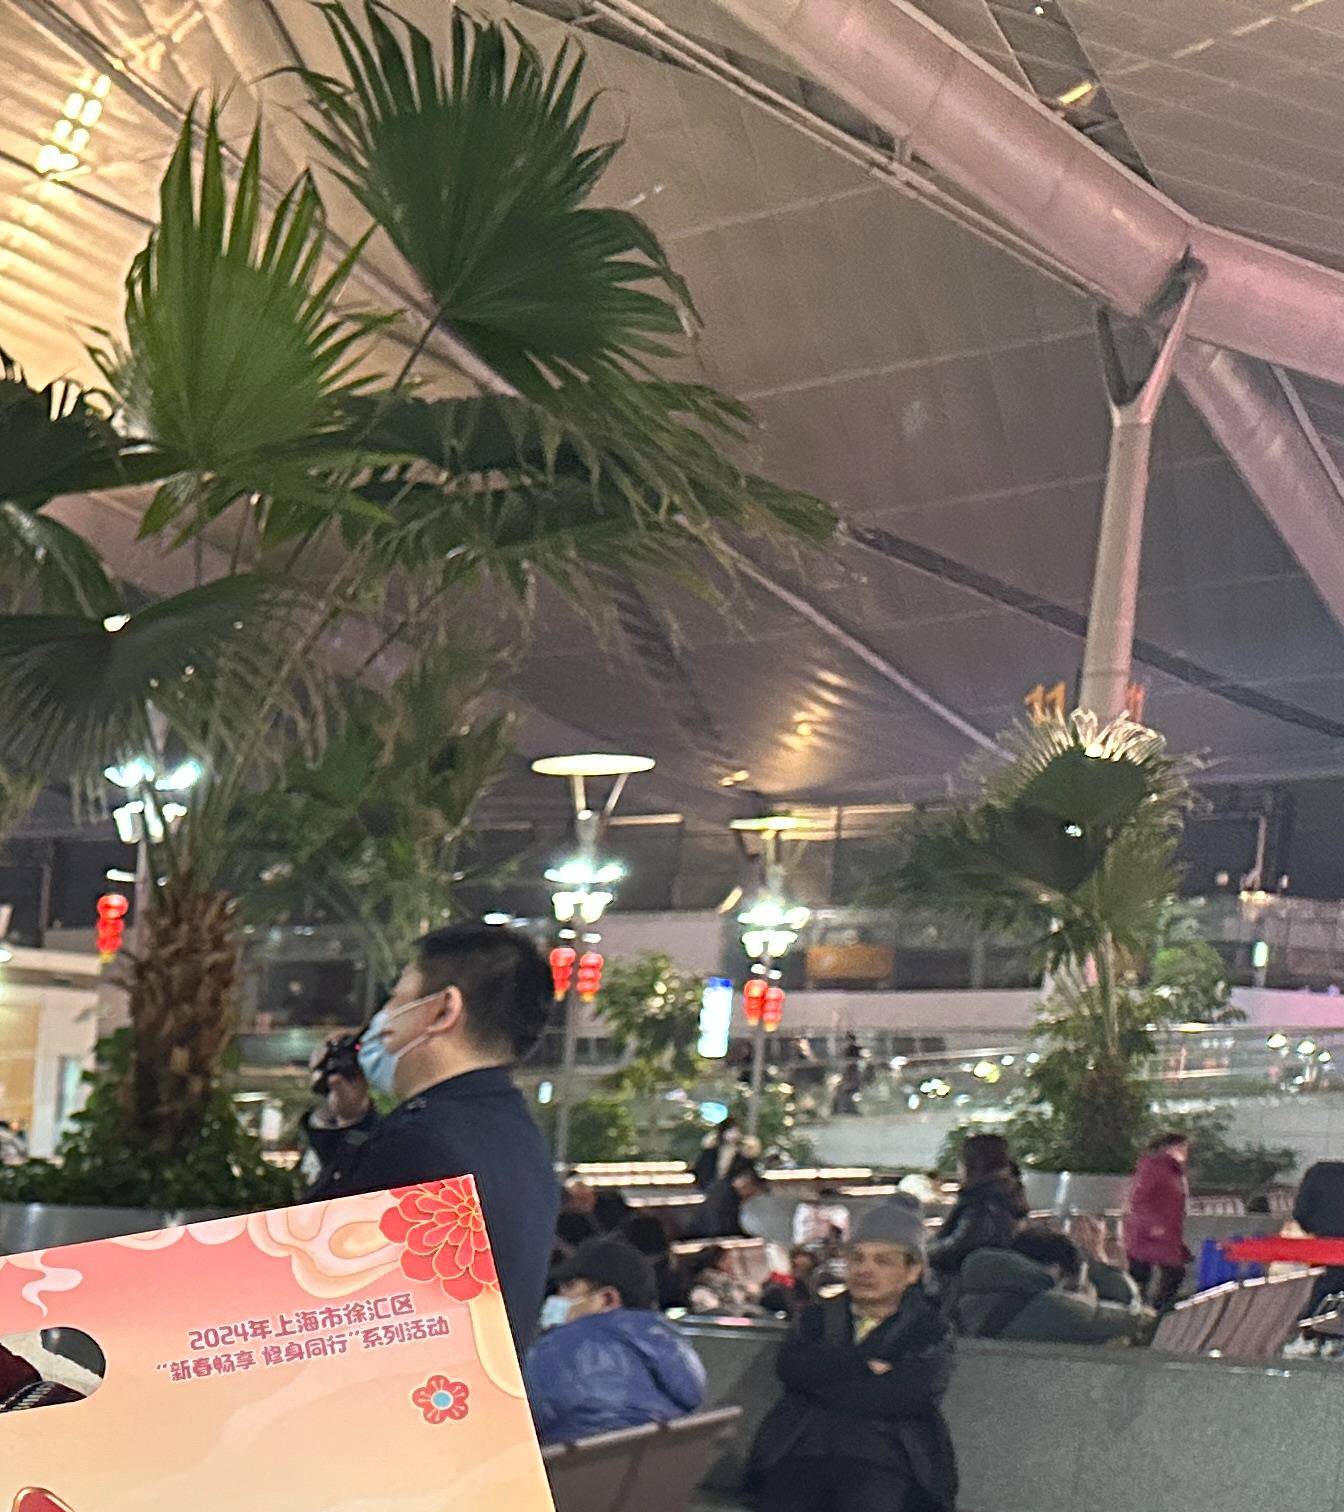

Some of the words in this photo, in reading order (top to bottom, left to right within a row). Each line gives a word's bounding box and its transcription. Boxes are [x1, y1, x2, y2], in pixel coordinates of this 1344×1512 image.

[188, 1293, 415, 1352] 2024年上海市徐汇区
